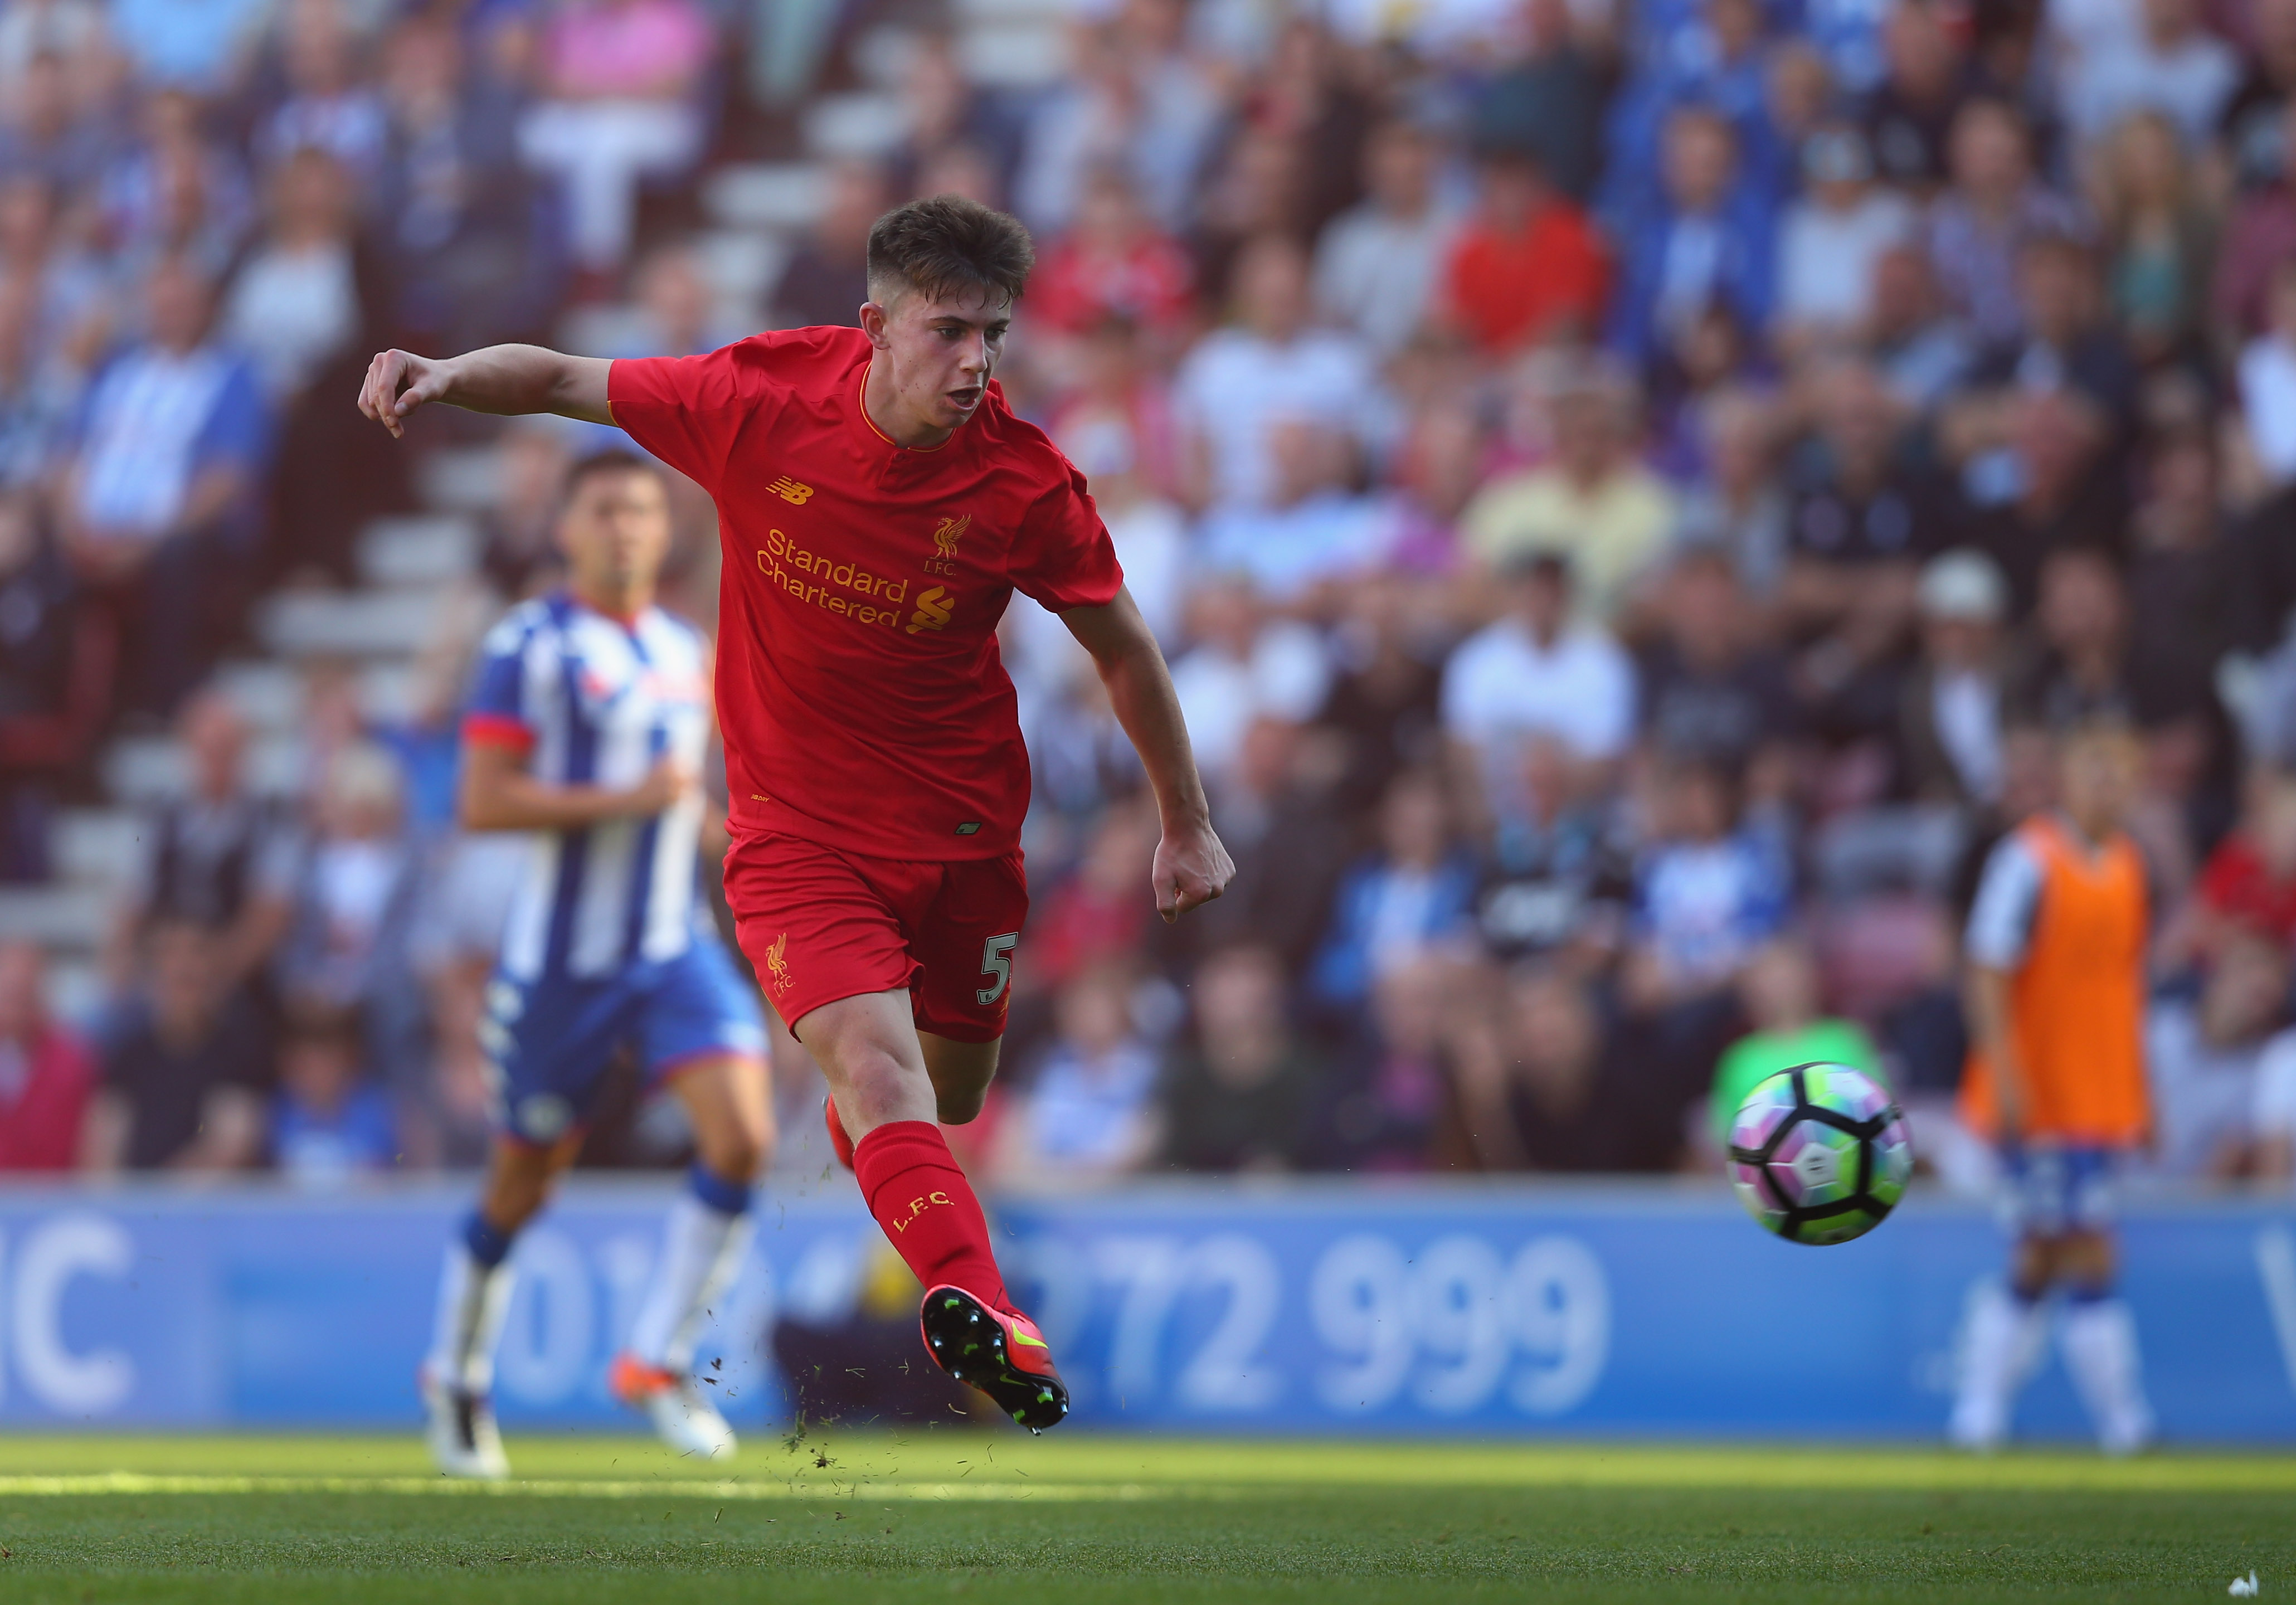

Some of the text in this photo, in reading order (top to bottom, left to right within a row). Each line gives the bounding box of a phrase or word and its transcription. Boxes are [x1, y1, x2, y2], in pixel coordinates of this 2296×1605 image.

[757, 549, 901, 628] Chartered
[767, 528, 908, 604] Standard
[976, 931, 1019, 1005] 5
[893, 1191, 955, 1234] L.F.C.
[1308, 1230, 1612, 1416] 999
